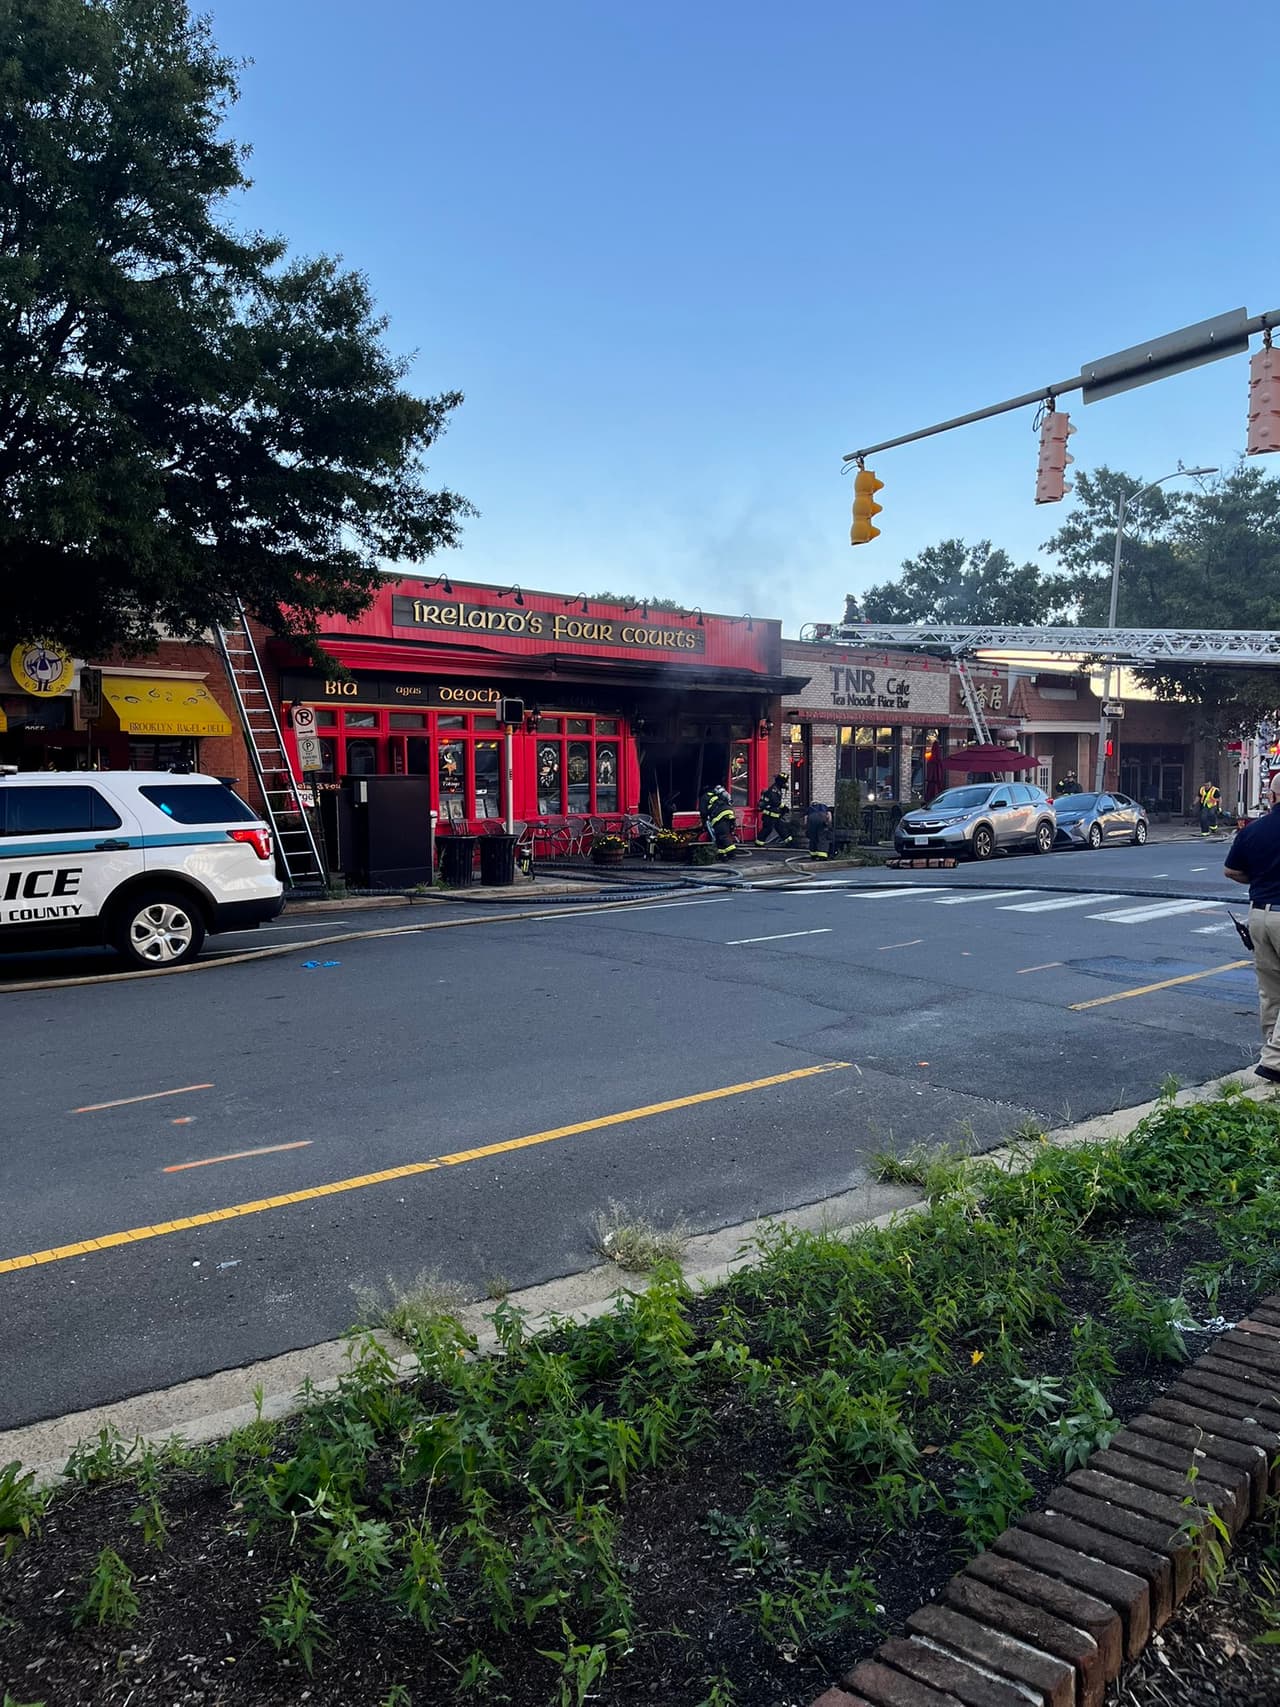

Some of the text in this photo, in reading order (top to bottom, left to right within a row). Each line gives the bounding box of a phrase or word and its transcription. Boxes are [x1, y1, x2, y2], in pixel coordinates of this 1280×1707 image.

[829, 665, 910, 696] TNR Cafe
[830, 692, 910, 709] Tea Noodle Rice Bar
[129, 722, 224, 733] BROOKLYN BAGEL DELI
[9, 904, 83, 921] COUNTY
